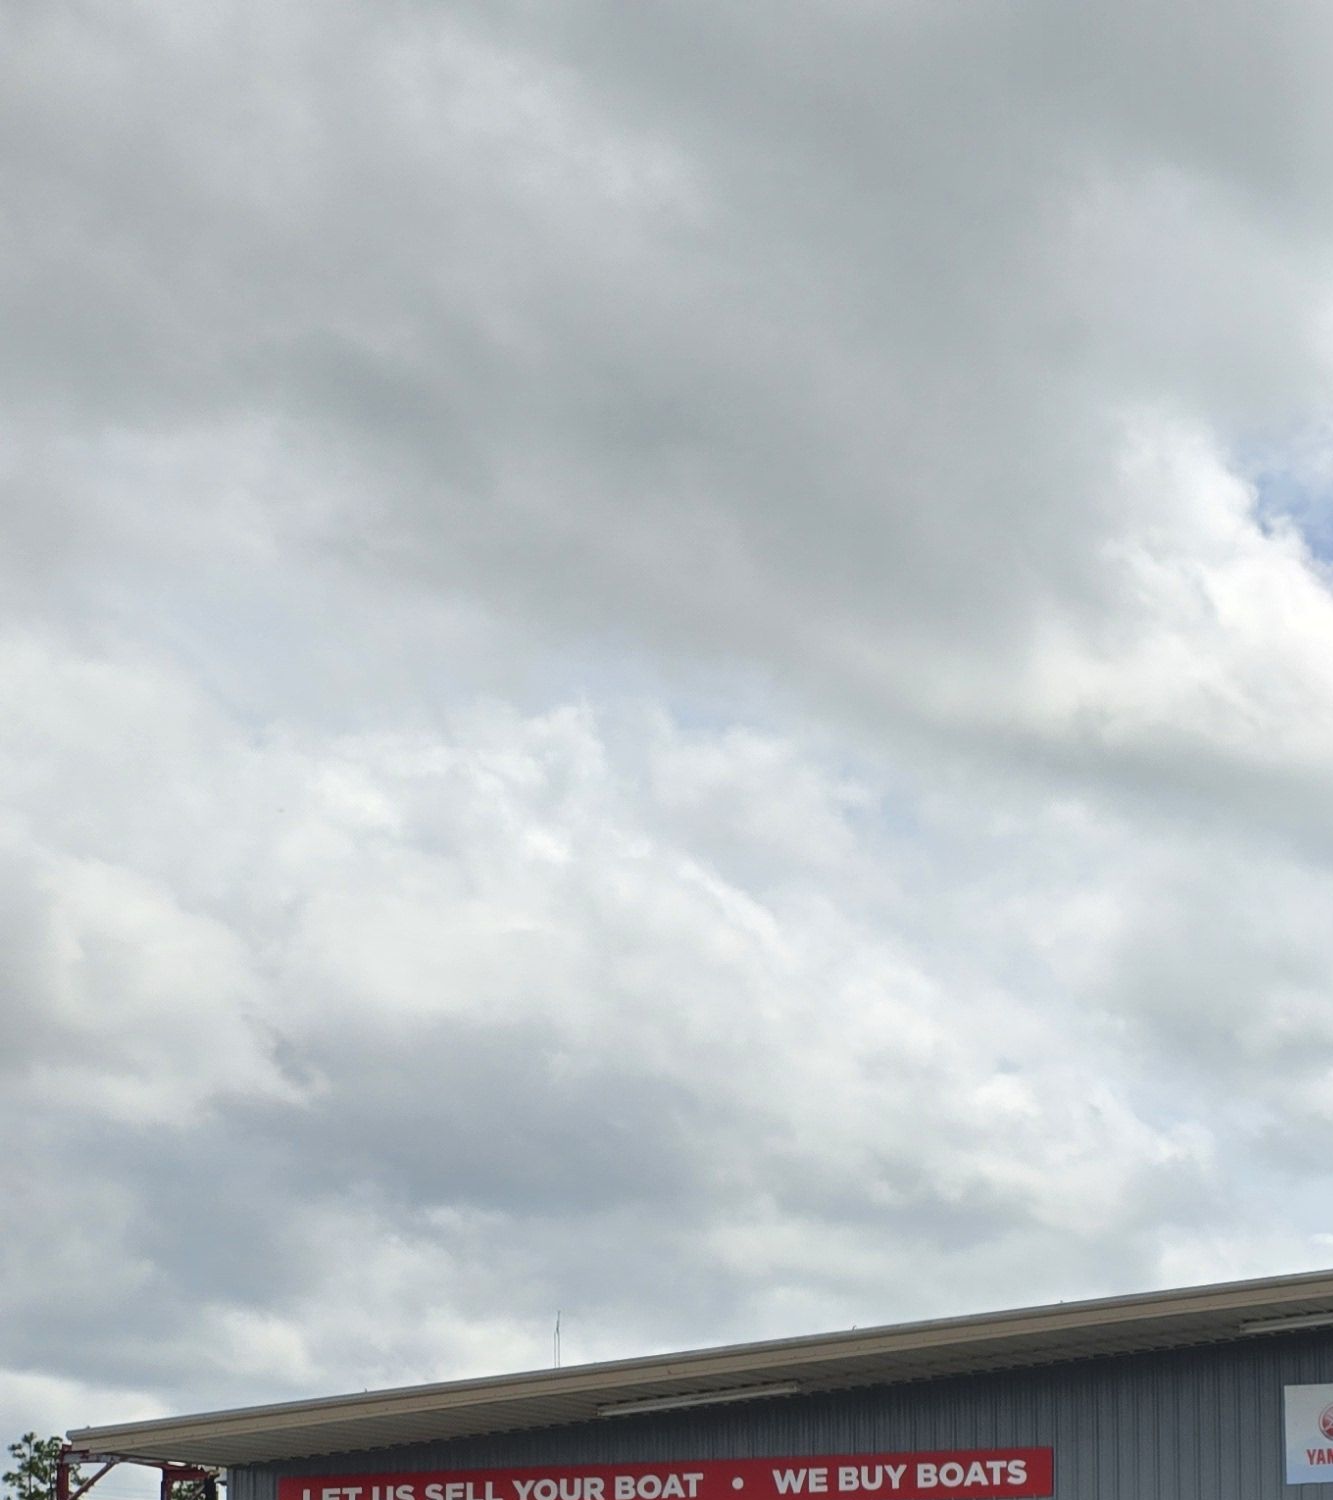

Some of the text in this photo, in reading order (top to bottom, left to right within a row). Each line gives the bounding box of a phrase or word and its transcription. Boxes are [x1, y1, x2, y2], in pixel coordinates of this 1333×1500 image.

[614, 1472, 703, 1500] BOAT
[771, 1468, 828, 1495] WE
[838, 1464, 906, 1491] BUY
[916, 1459, 1027, 1488] BOATS
